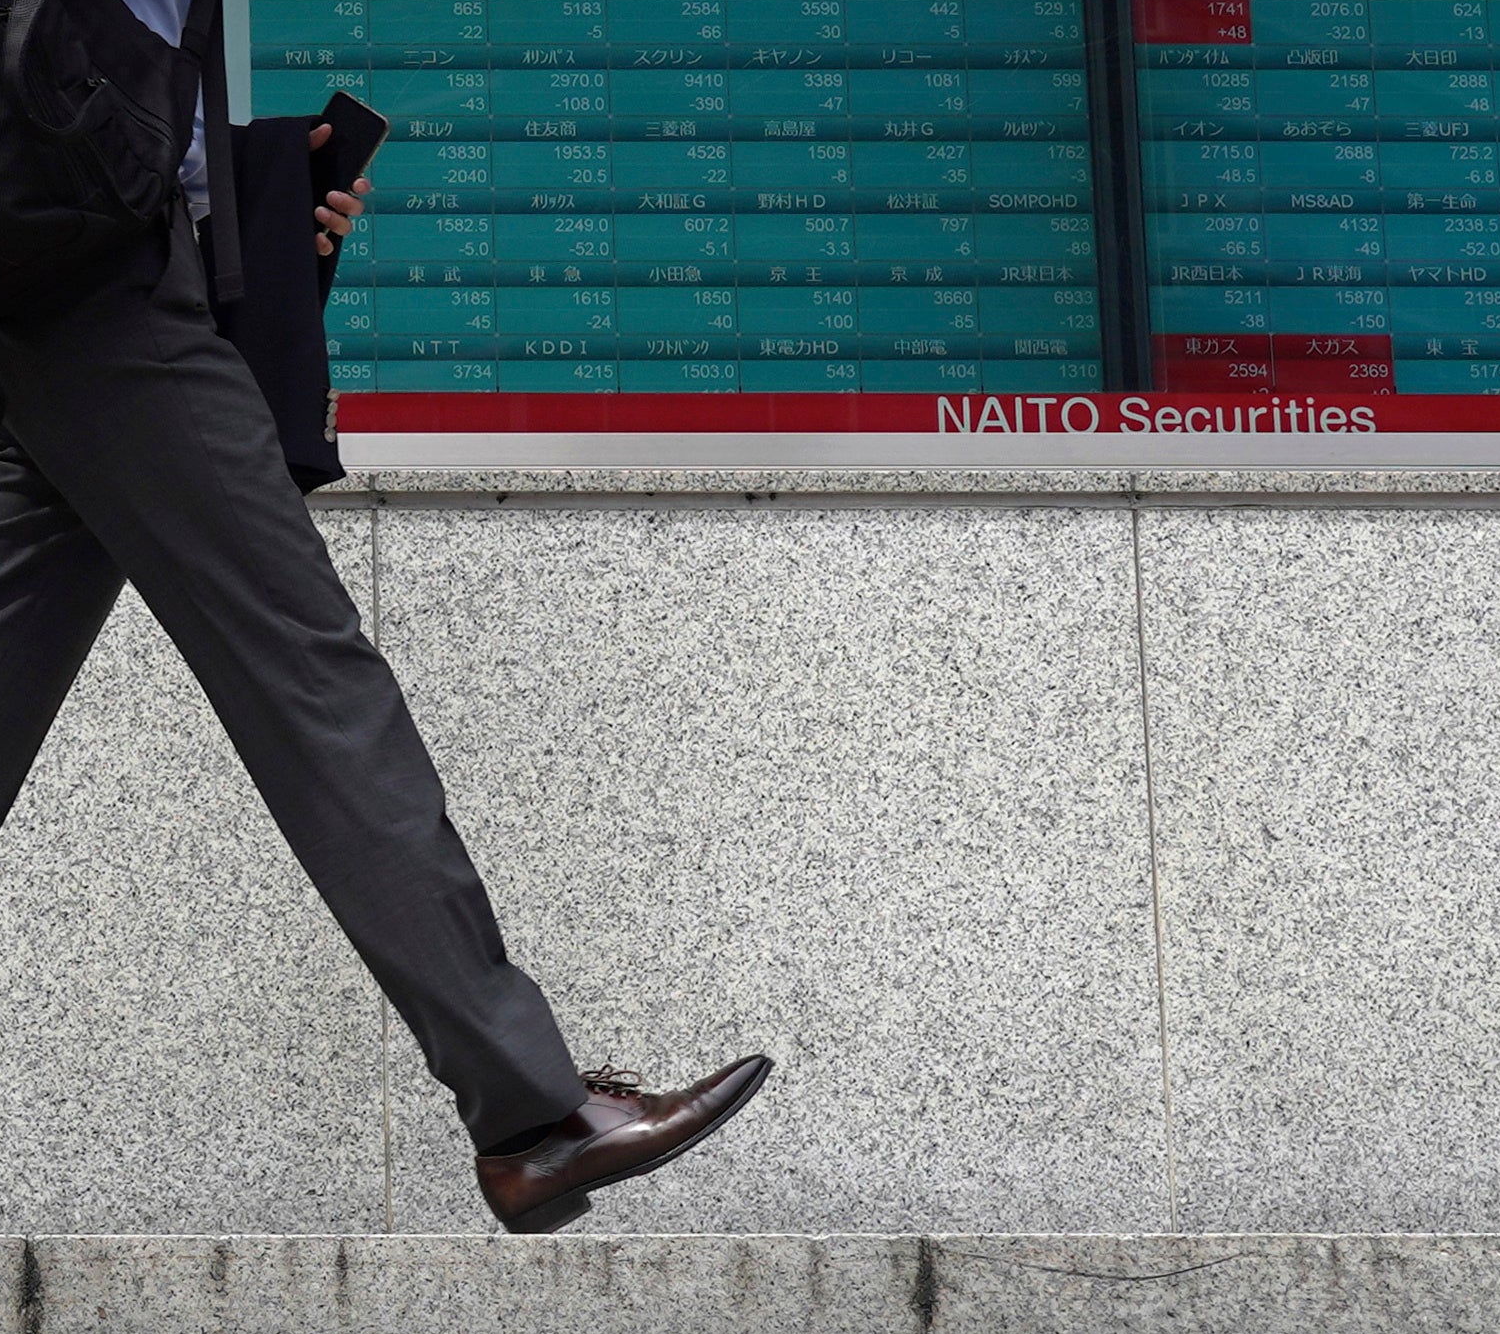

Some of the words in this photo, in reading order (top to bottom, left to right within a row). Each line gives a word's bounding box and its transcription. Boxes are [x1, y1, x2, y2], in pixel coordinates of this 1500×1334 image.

[333, 0, 364, 16] 426
[1033, 0, 1076, 16] 529.1
[1309, 1, 1365, 17] 2076.0
[347, 24, 364, 40] -6
[1048, 24, 1080, 40] -6.3
[1325, 24, 1366, 40] -32.0
[881, 48, 932, 64] リコー
[446, 73, 485, 89] 1583
[803, 72, 843, 88] 3389
[923, 71, 963, 88] 1081
[458, 96, 485, 111] -43
[818, 95, 844, 111] -47
[937, 95, 963, 112] -19
[523, 119, 577, 137] 住友商
[1171, 119, 1225, 136] イオン
[1403, 120, 1470, 137] 三菱UFJ
[553, 144, 607, 160] 1953.5
[1200, 144, 1256, 160] 2715.0
[1448, 144, 1493, 160] 725.2
[566, 167, 608, 184] -20.5
[1215, 167, 1256, 183] -48.5
[1463, 168, 1496, 184] -6.8
[405, 191, 459, 210] みずほ
[987, 193, 1078, 209] SOMPOHD
[1290, 193, 1354, 208] MS&AD
[435, 217, 489, 233] 1582.5
[1050, 215, 1090, 232] 5823
[1338, 215, 1379, 232] 4132
[458, 241, 490, 258] -5.0
[1064, 240, 1092, 256] -89
[1354, 240, 1381, 256] -49
[648, 264, 702, 283] 小田急
[692, 289, 732, 305] 1850
[707, 314, 733, 329] -40
[936, 396, 1099, 434] NAITO
[1119, 396, 1377, 434] Securities
